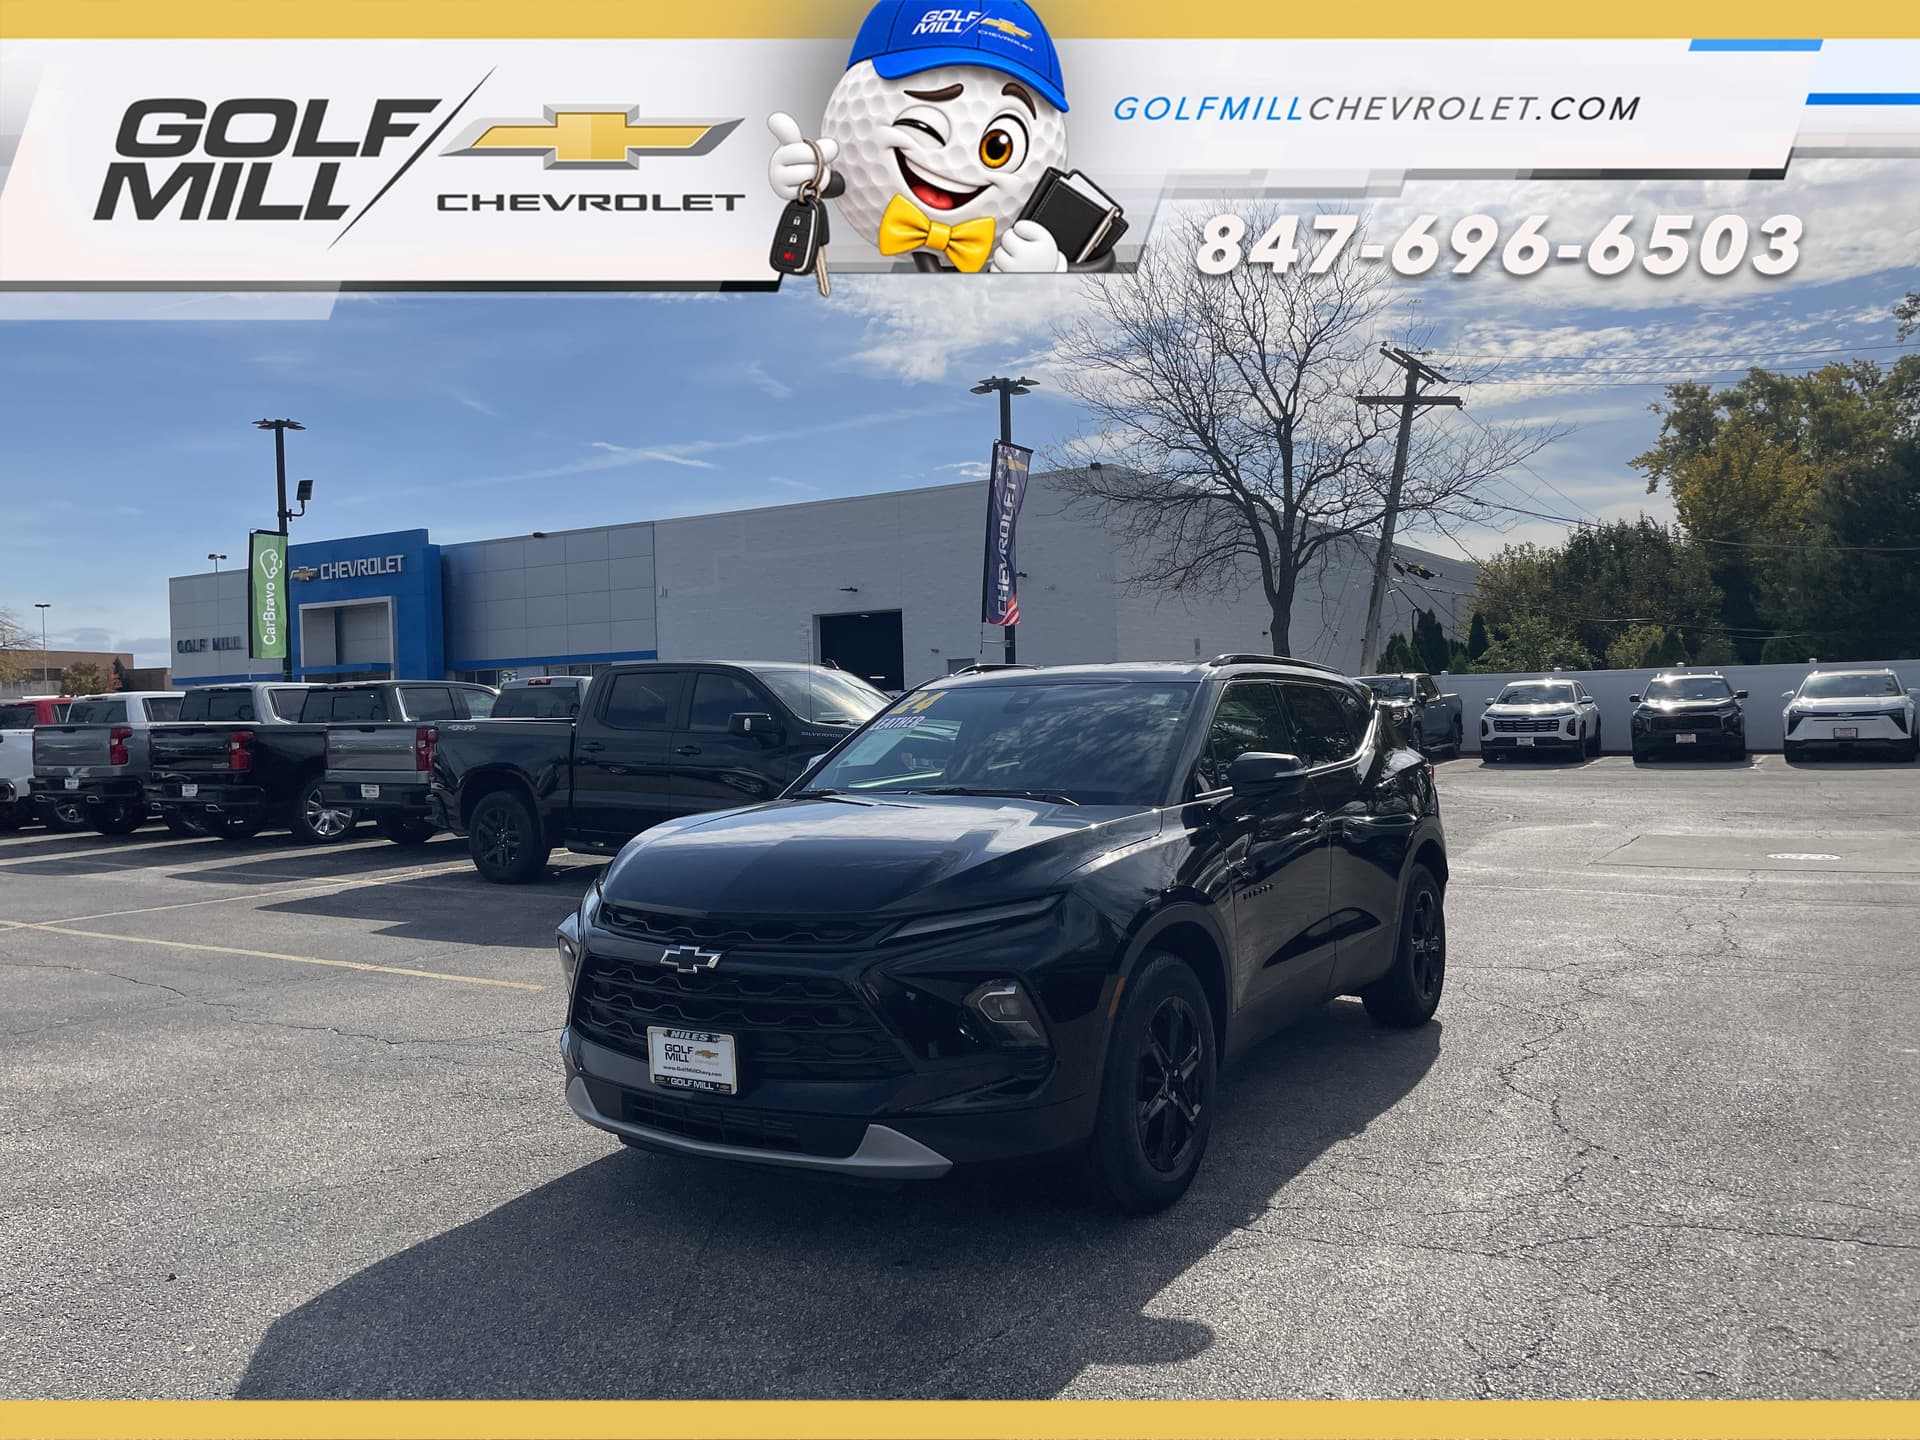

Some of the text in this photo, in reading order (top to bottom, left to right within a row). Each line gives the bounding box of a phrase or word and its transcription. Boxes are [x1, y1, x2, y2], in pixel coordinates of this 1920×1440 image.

[996, 482, 1018, 616] CHEVROLET
[320, 554, 405, 580] CHEVROLET
[262, 582, 276, 645] CarBravo
[869, 715, 926, 730] LEATHER
[671, 1030, 710, 1041] NILES
[665, 1044, 693, 1054] GOLF
[665, 1052, 689, 1062] MILL
[671, 1078, 714, 1090] GOLF MILL
